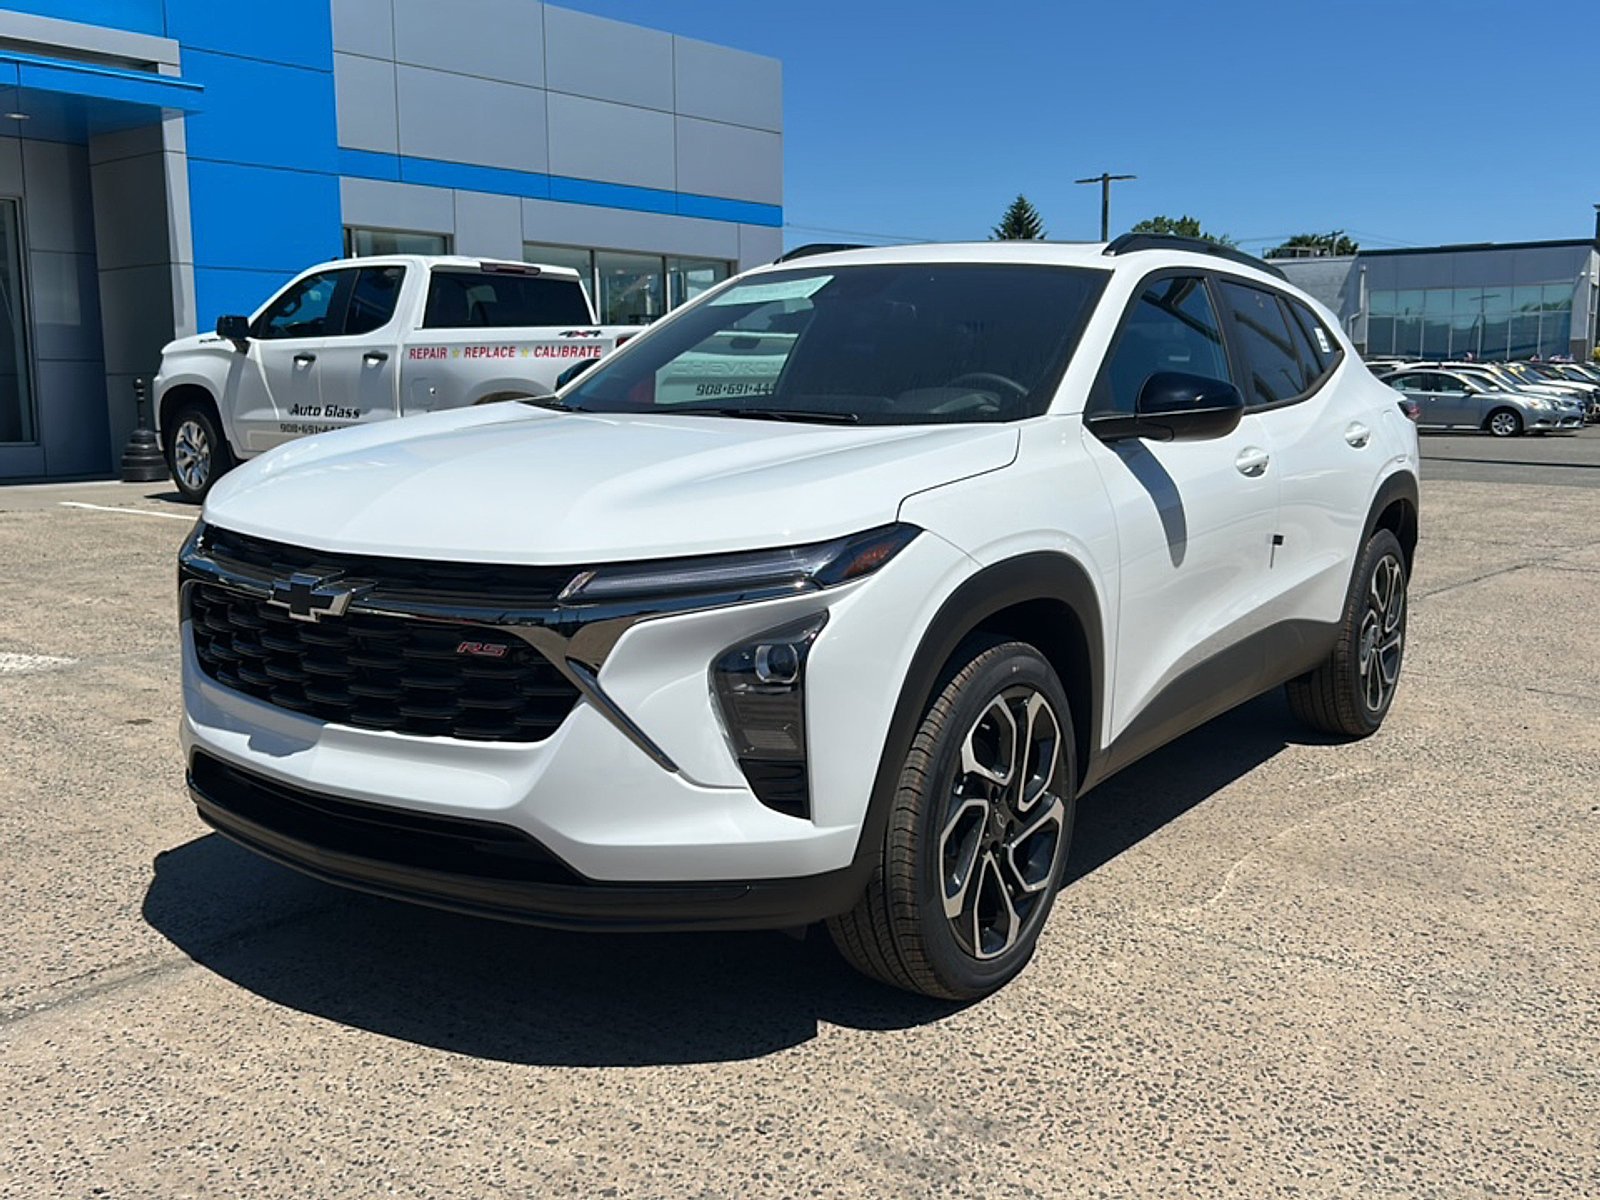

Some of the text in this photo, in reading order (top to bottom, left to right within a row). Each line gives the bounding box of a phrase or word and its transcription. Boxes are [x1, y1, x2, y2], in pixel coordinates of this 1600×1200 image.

[409, 345, 602, 359] REPAIR REPLACE CALIBRATE
[289, 403, 361, 419] Auto Glass
[456, 641, 507, 657] RS
